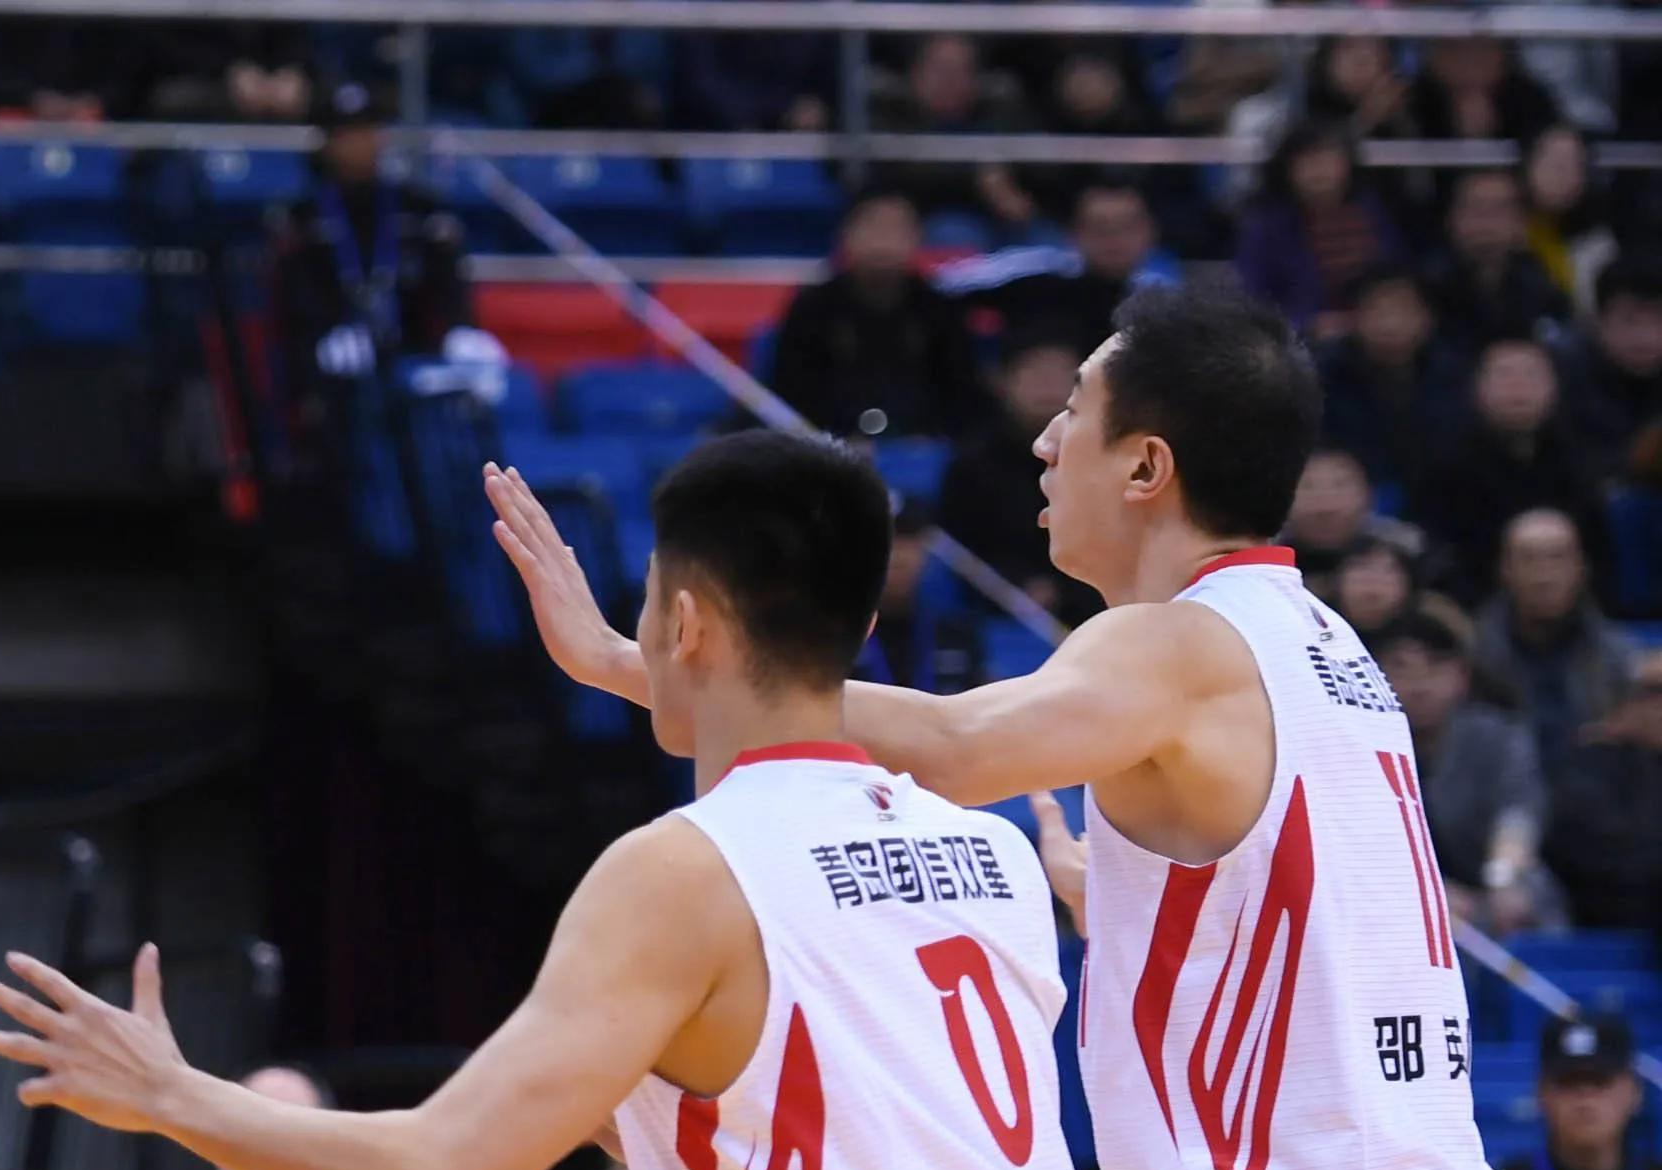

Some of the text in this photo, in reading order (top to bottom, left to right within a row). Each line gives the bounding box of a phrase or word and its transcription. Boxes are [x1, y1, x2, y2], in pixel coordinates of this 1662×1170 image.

[809, 835, 1014, 909] 青岛国信双星
[915, 934, 1034, 1168] 0
[1374, 1015, 1471, 1082] 邵英
